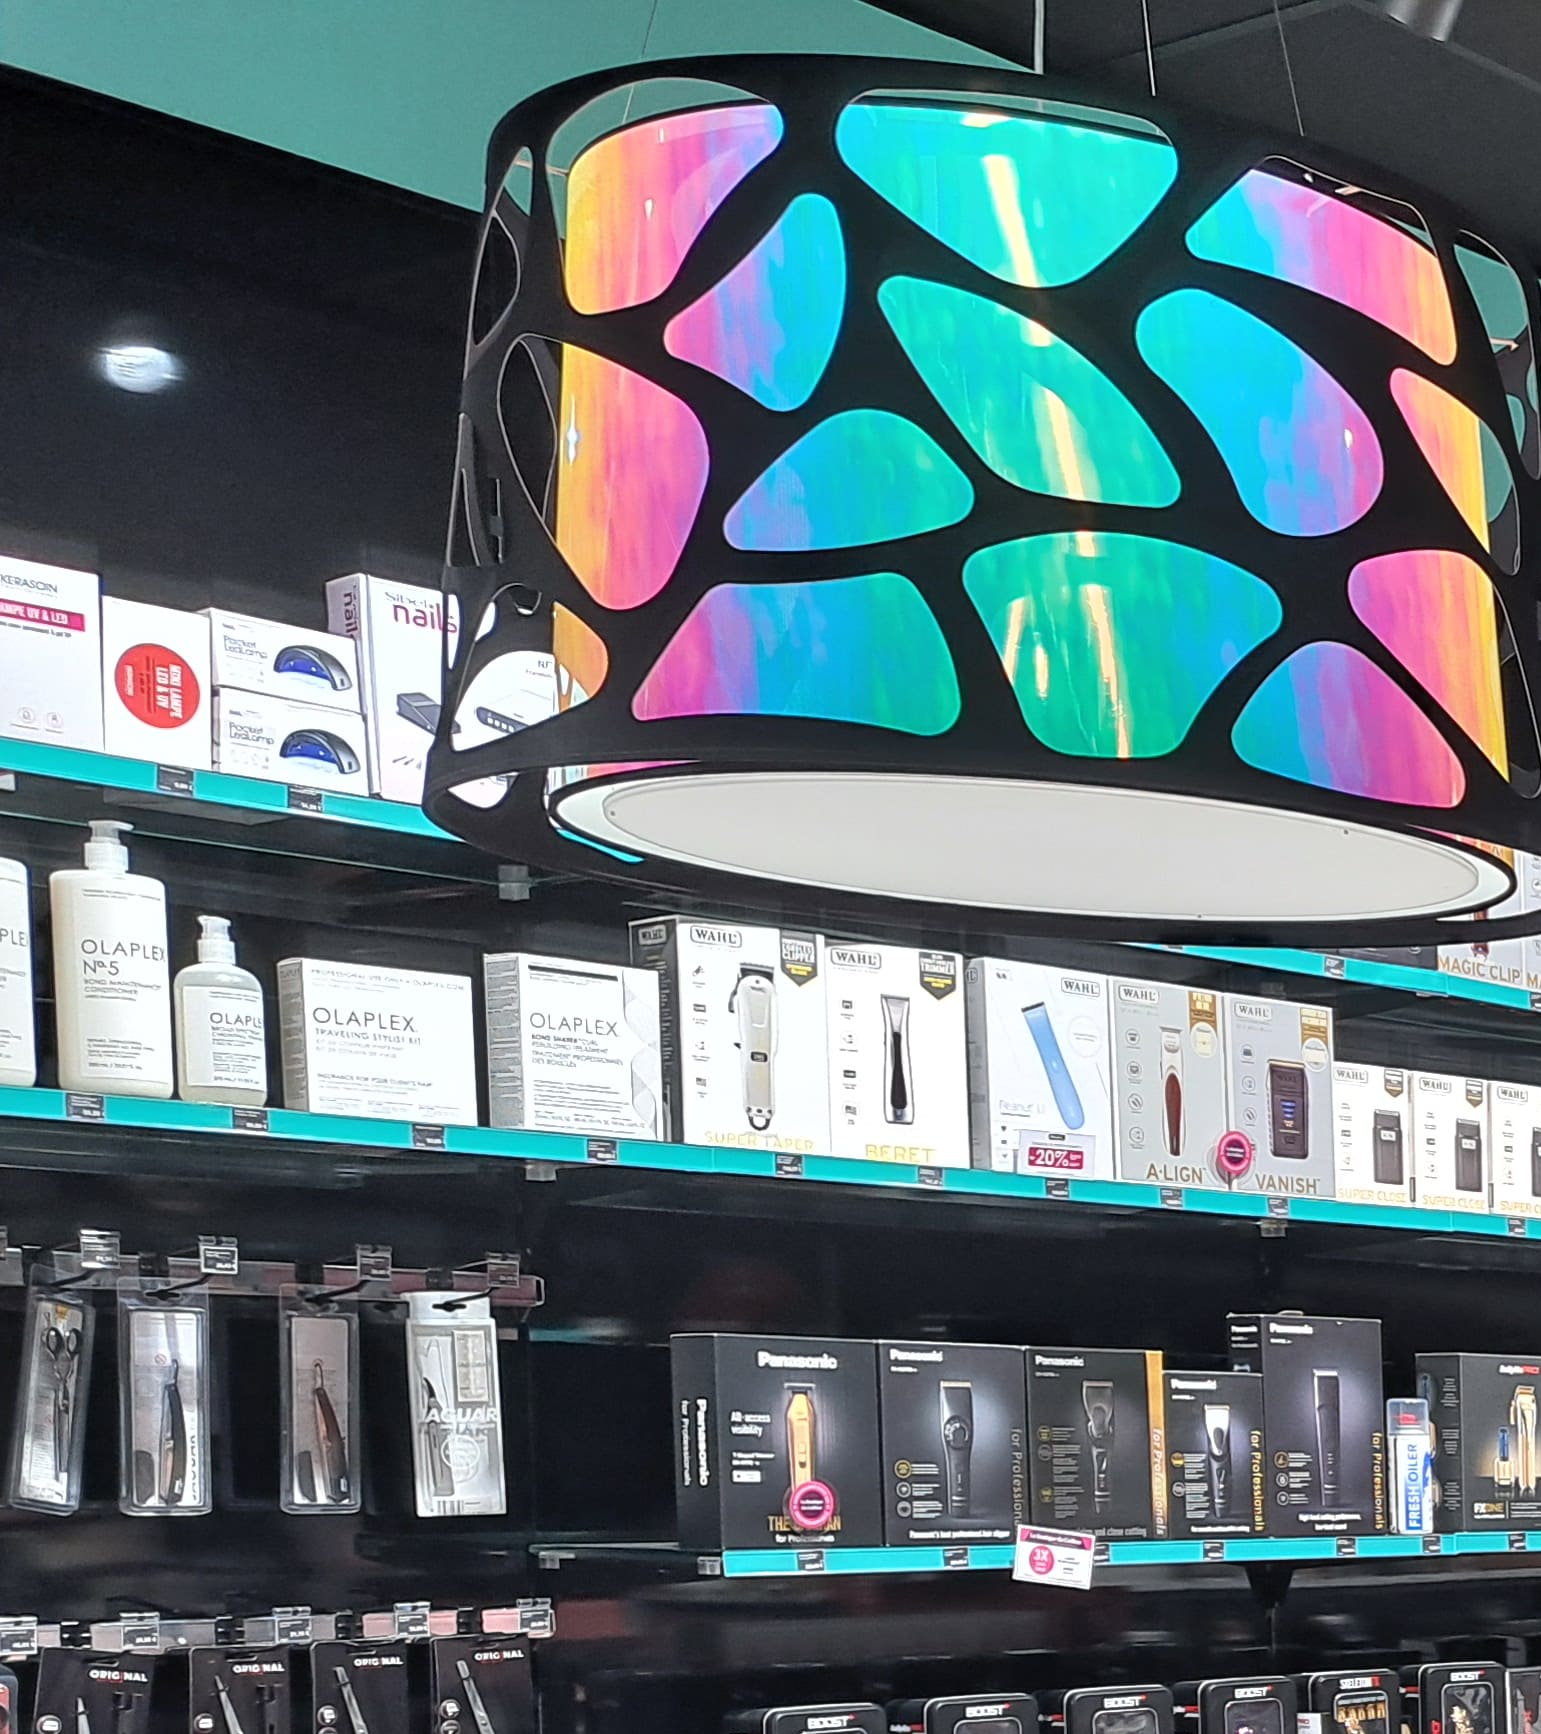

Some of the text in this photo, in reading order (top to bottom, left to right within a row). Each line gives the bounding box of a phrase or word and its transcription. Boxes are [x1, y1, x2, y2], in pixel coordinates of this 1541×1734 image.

[692, 929, 738, 945] WAHL
[836, 952, 877, 966] WAHL
[1437, 958, 1521, 983] MAGIC CLIP
[1063, 980, 1098, 995] WAHL
[1123, 988, 1157, 1001] WAHL
[312, 1007, 414, 1032] OLAPLEX
[1238, 1006, 1270, 1018] WAHL
[530, 1013, 618, 1037] OLAPLEX
[315, 1028, 370, 1041] TRAVELING
[1337, 1070, 1366, 1081] WAHL
[1423, 1079, 1449, 1091] WAHL
[1500, 1088, 1525, 1100] WAHL
[705, 1131, 758, 1146] SUPER
[865, 1144, 936, 1164] BERET
[1029, 1148, 1069, 1167] -20%
[1256, 1174, 1318, 1193] VANISH
[1338, 1188, 1373, 1200] SUPER
[1500, 1202, 1528, 1213] SUPER
[758, 1351, 838, 1369] Panasonic
[889, 1349, 943, 1362] Panasonic
[1035, 1355, 1084, 1368] Panasonic
[1171, 1379, 1217, 1390] Panasonic
[697, 1399, 709, 1486] Panasonic
[1151, 1428, 1167, 1536] for Professionals
[1250, 1429, 1264, 1532] for Professionals
[1373, 1432, 1383, 1530] for Professionals
[1408, 1444, 1422, 1529] FRESH OILER
